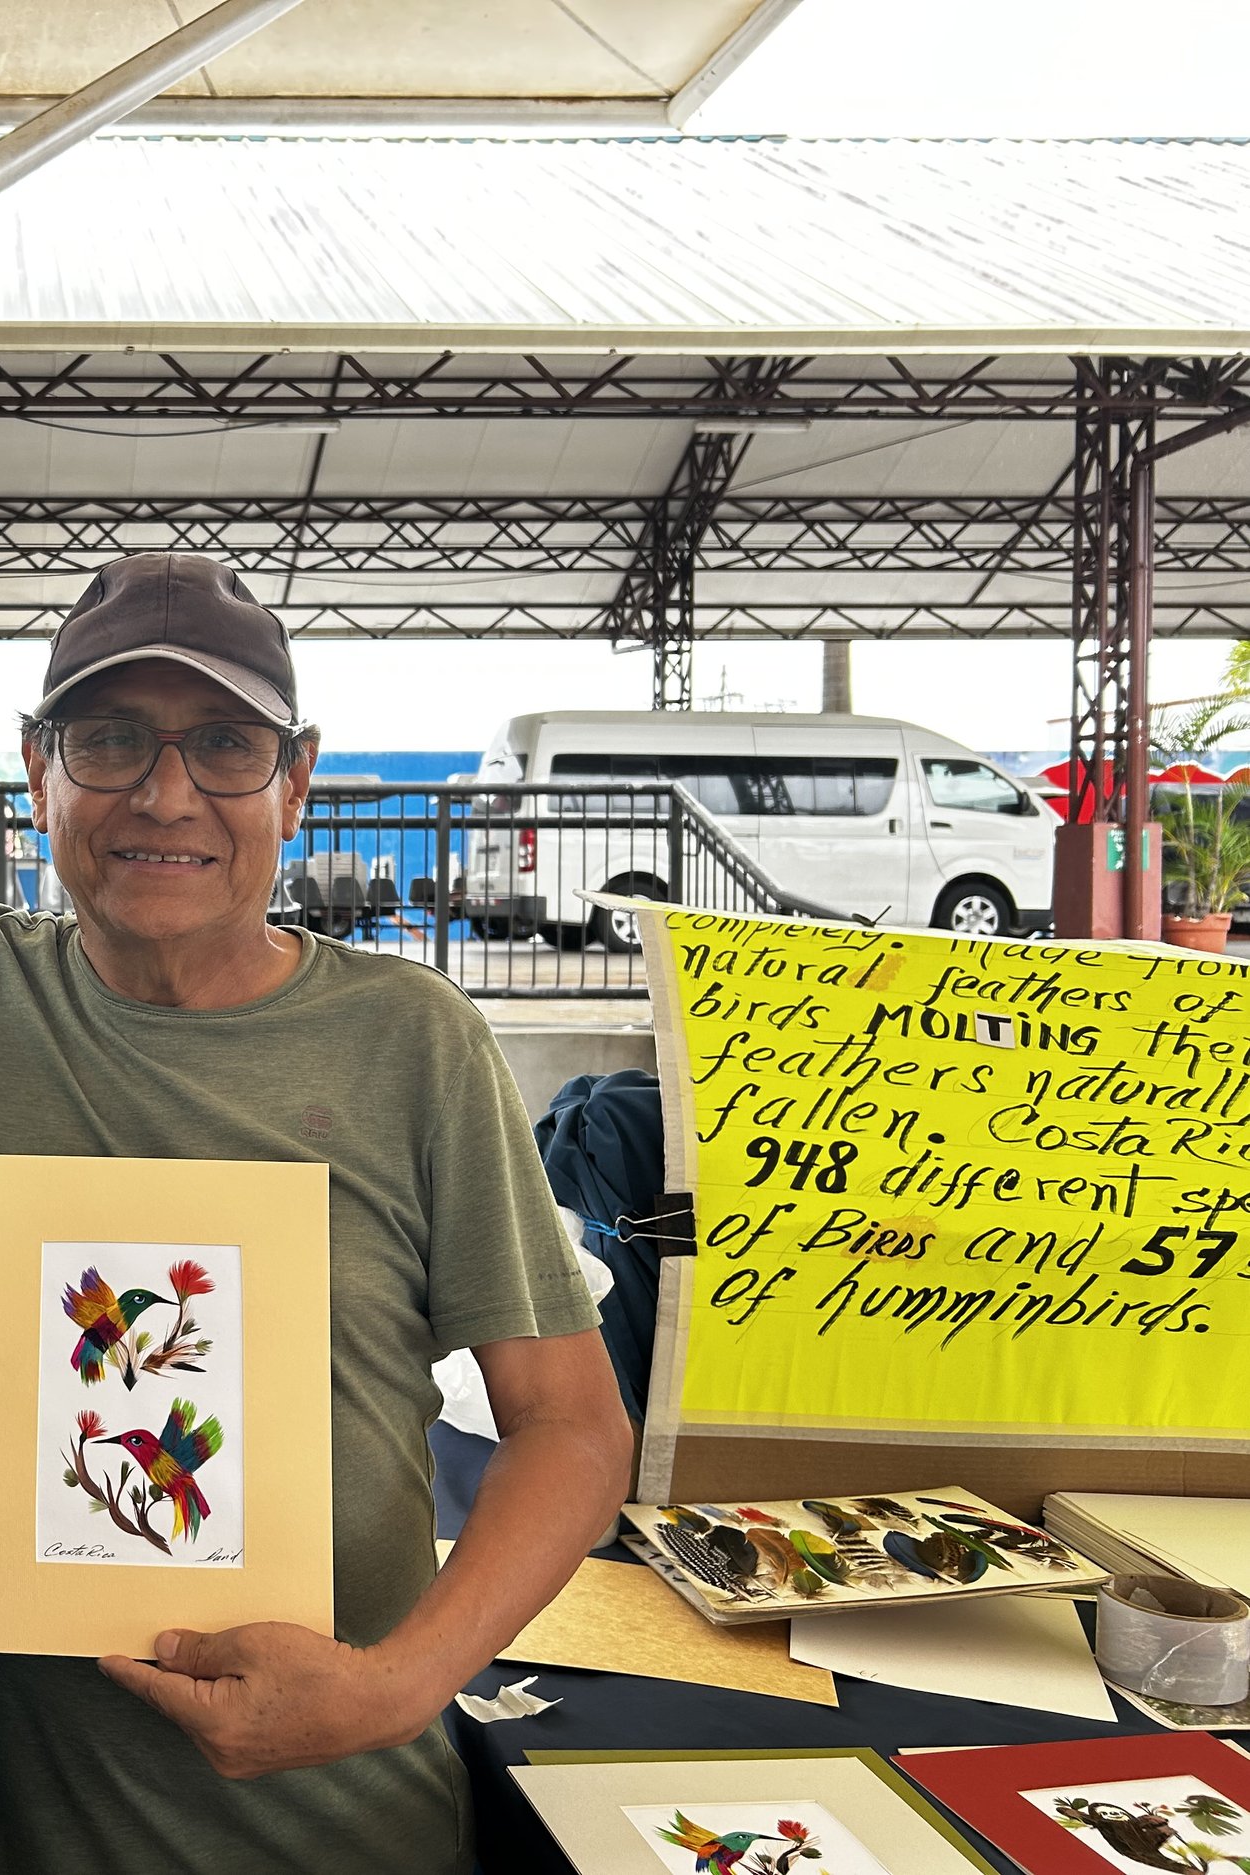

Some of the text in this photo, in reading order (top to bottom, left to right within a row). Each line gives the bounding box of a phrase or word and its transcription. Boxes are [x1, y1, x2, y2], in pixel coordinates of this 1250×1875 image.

[680, 944, 1244, 1023] natural feathers of
[689, 982, 830, 1031] birds
[689, 1031, 994, 1095] feathers
[696, 1083, 946, 1154] fallen.
[988, 1103, 1158, 1156] Costa
[744, 1136, 859, 1194] 948
[879, 1148, 1179, 1218] different
[706, 1202, 798, 1259] of
[964, 1222, 1105, 1276] and
[1120, 1225, 1239, 1278] 57
[711, 1260, 1211, 1350] of humminbirds.
[44, 1542, 116, 1559] Costa Rica
